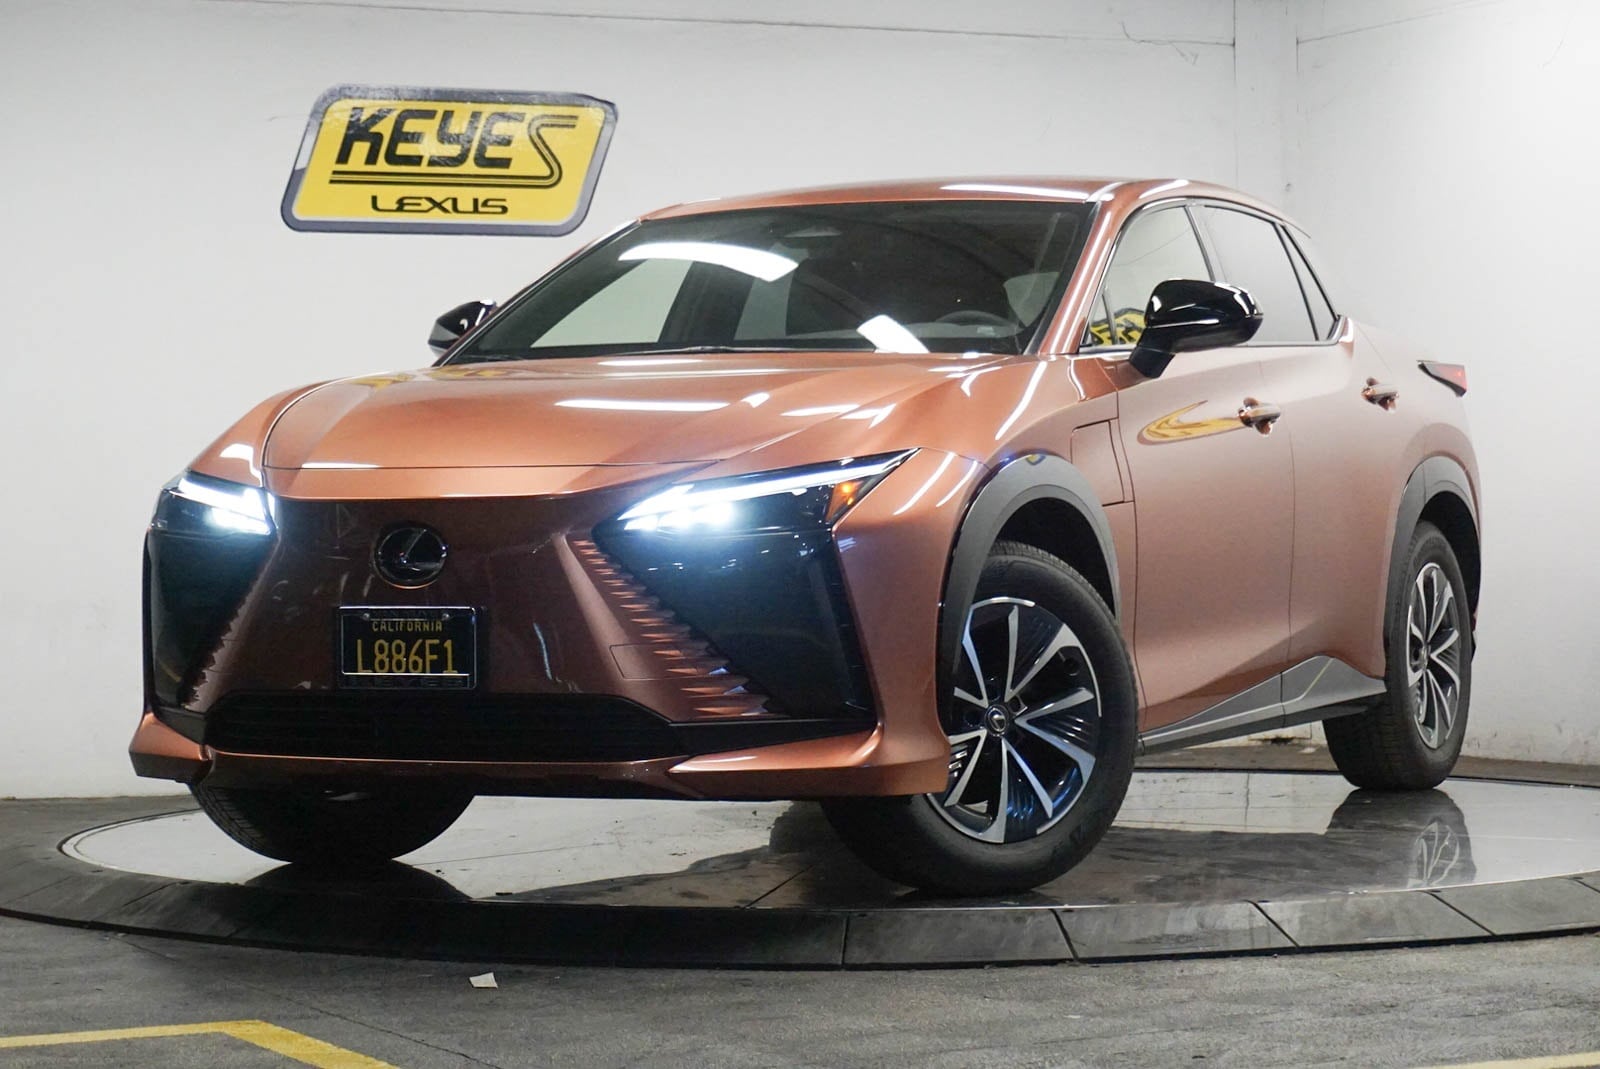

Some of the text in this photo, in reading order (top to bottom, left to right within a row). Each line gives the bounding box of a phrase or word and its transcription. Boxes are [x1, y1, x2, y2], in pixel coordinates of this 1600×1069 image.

[331, 106, 578, 188] KEYES
[371, 194, 509, 215] LEXUS
[372, 621, 443, 632] CALIFORNIA
[356, 639, 458, 674] L886F1
